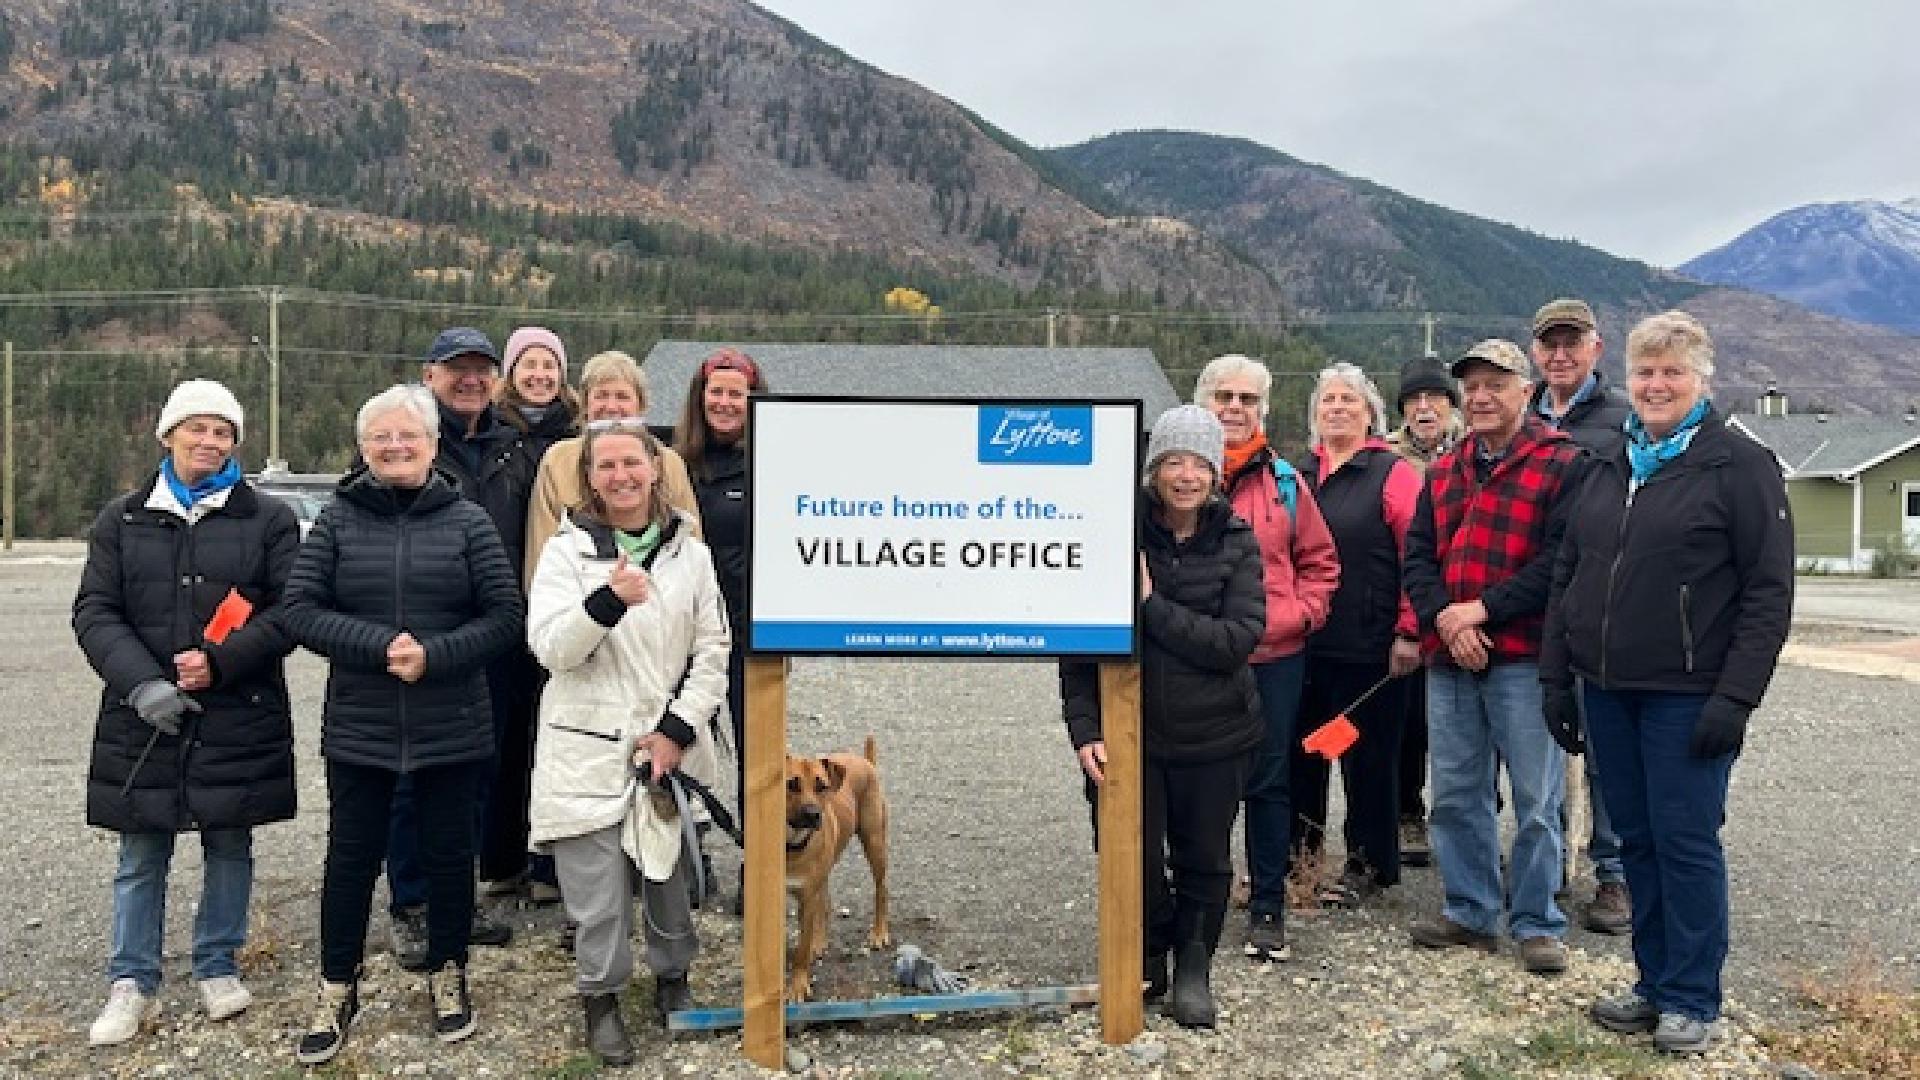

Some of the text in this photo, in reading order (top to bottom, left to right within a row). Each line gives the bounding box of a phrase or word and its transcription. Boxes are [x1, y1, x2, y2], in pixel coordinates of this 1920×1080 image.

[989, 419, 1083, 457] Lytton
[795, 494, 1084, 520] Future home of the...
[796, 537, 1084, 570] VILLAGE OFFICE
[845, 633, 883, 646] LEARN
[885, 633, 918, 646] MORE
[941, 632, 1046, 651] www.lytton.ca
